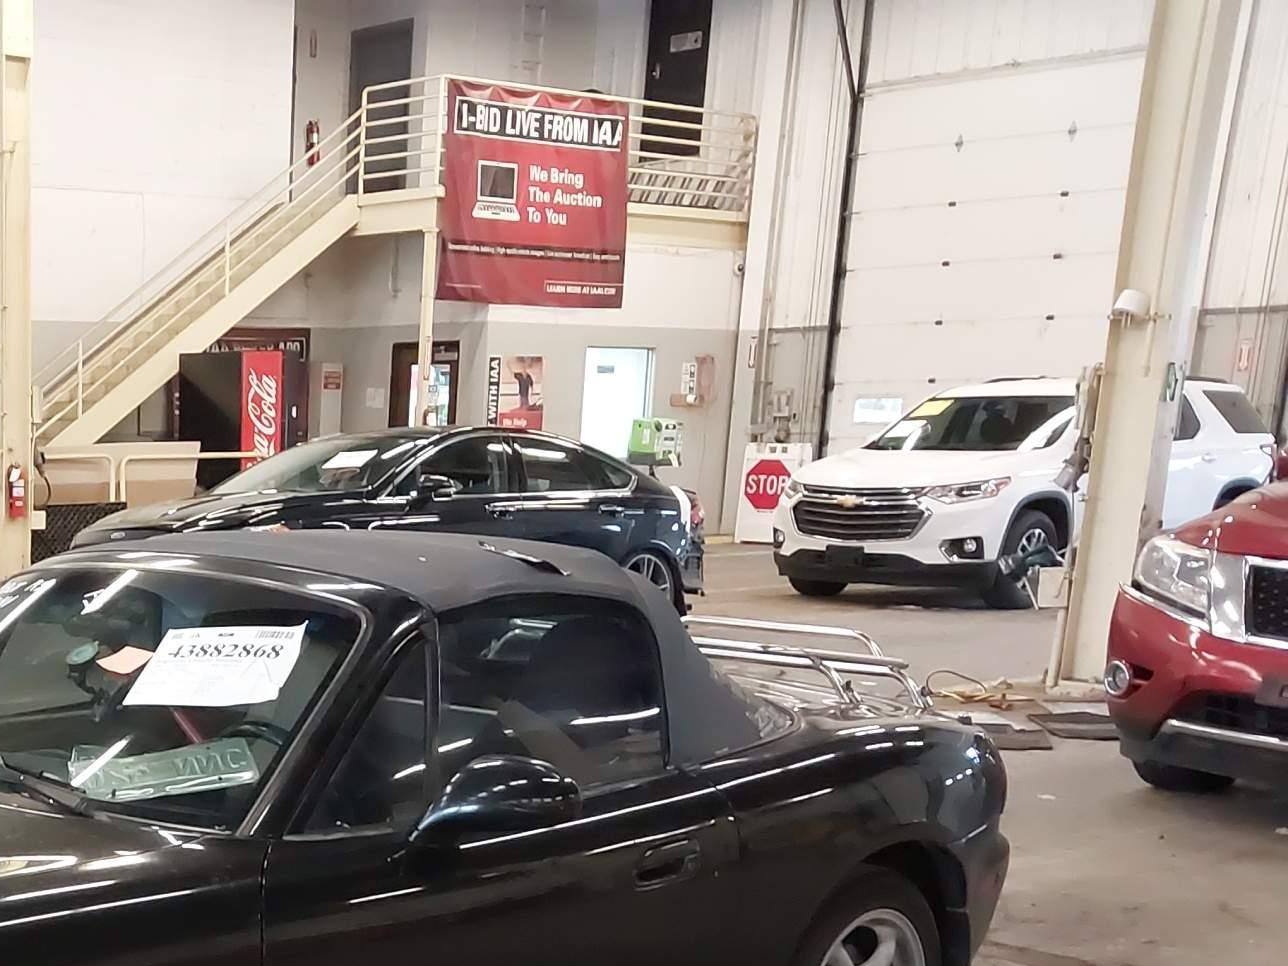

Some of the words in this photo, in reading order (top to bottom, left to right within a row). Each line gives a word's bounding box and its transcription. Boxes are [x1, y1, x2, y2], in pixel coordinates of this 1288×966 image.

[462, 103, 501, 132] I-BID
[505, 109, 542, 138] LIVE
[544, 114, 589, 142] FROM
[529, 164, 548, 182] We
[550, 167, 584, 189] Bring
[528, 185, 551, 203] The
[553, 188, 603, 208] Auction
[527, 206, 542, 223] To
[545, 207, 568, 225] You
[490, 359, 500, 382] IAA
[488, 385, 498, 419] WITH
[746, 474, 789, 495] STOP
[168, 643, 284, 659] 43882868
